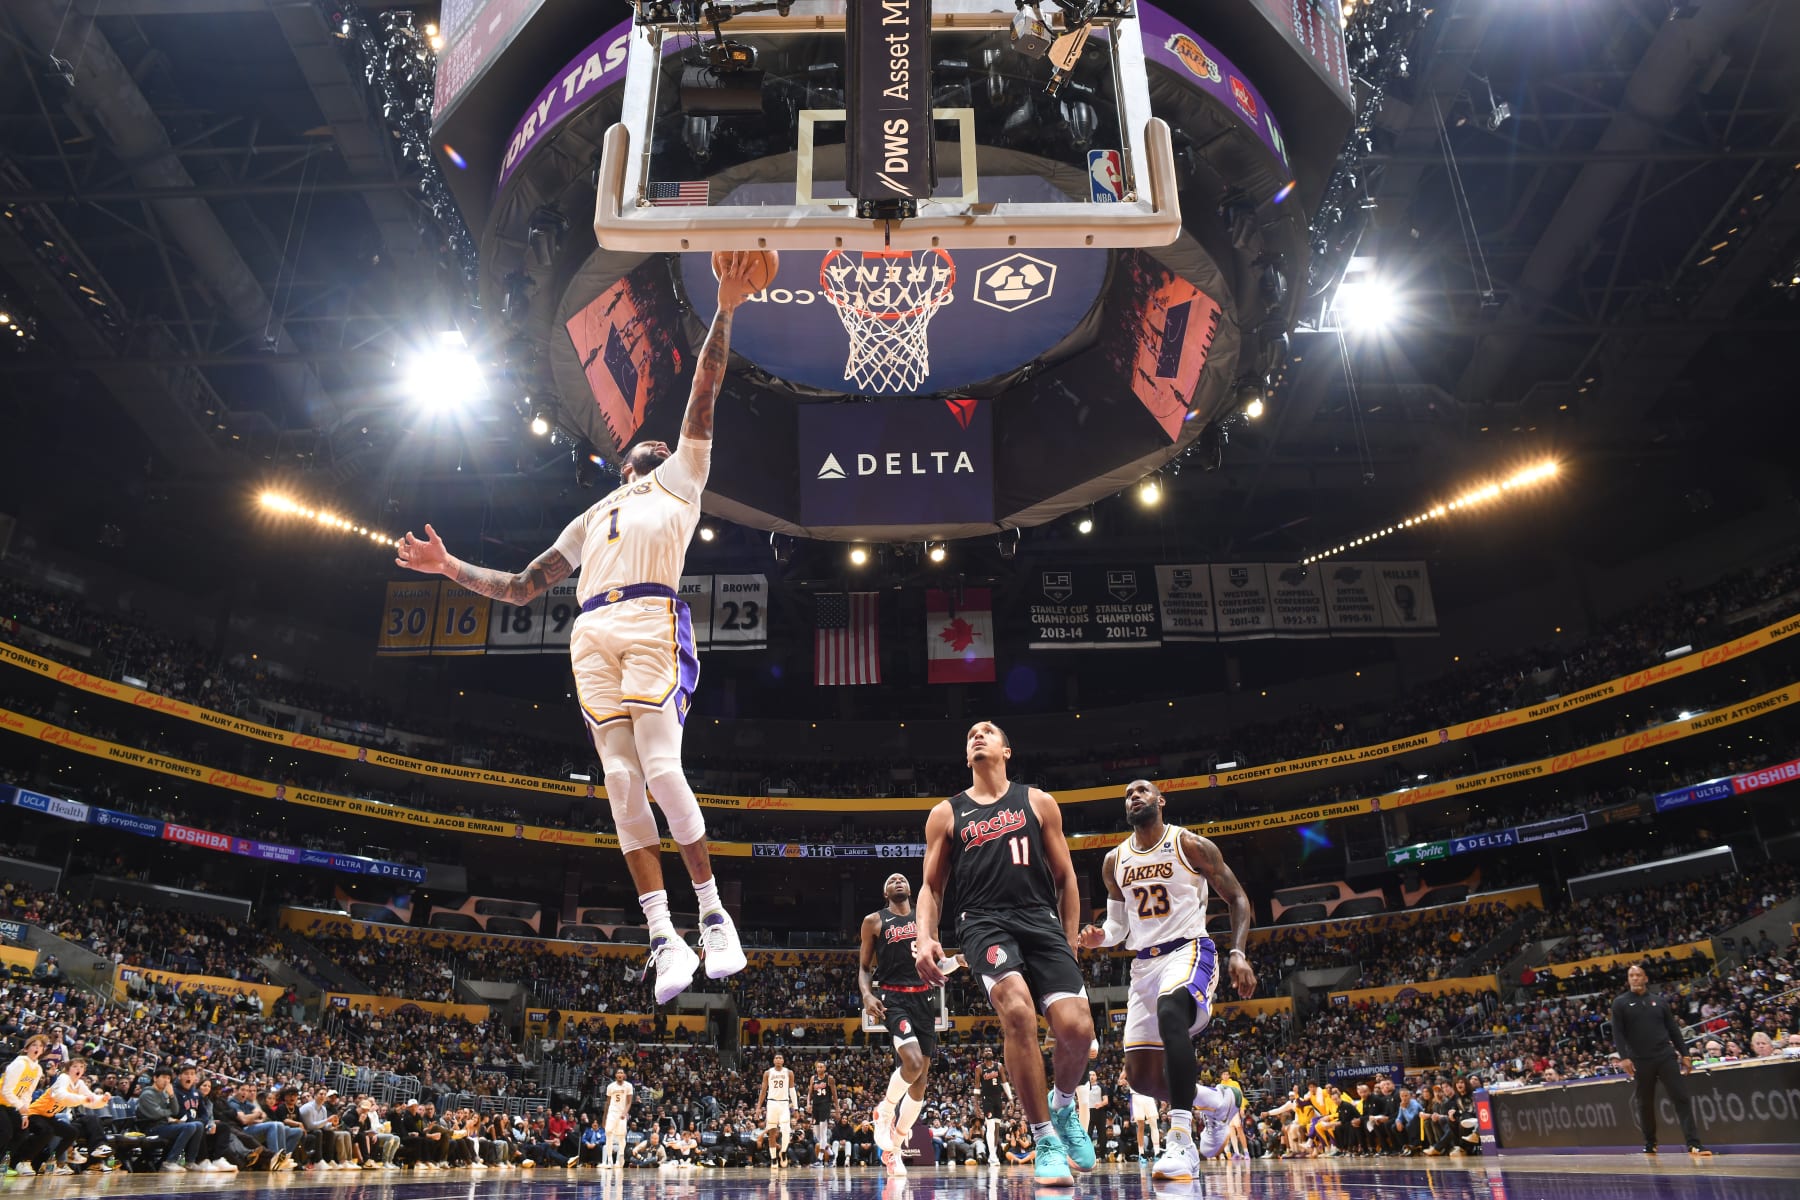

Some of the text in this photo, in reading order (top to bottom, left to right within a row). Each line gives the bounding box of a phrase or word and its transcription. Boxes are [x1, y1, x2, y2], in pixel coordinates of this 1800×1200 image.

[562, 31, 632, 103] TAS
[883, 29, 910, 101] Asset
[884, 118, 909, 175] DWS
[1096, 193, 1113, 203] NBA
[857, 451, 975, 476] DELTA
[607, 507, 621, 545] 1
[1044, 574, 1070, 585] LA
[1109, 573, 1134, 584] LA
[1382, 570, 1420, 579] MILLER
[722, 582, 761, 593] BROWN
[721, 600, 760, 630] 23
[1030, 603, 1088, 614] STANLEY CUP
[1095, 603, 1153, 614] STANLEY CUP
[1222, 607, 1265, 616] CHAMPIONS
[387, 608, 427, 636] 30
[445, 607, 477, 635] 16
[500, 605, 531, 634] 18
[1031, 613, 1089, 624] CHAMPIONS
[1095, 612, 1155, 624] CHAMPIONS
[1039, 626, 1083, 639] 2013-14
[1105, 625, 1147, 638] 2011-12
[1528, 686, 1615, 718] INJURY ATTORNEYS
[1691, 693, 1789, 730] INJURY ATTORNEYS
[200, 712, 285, 742] INJURY ATTORNEYS
[109, 747, 202, 778] INJURY ATTORNEYS
[1227, 737, 1429, 783] ACCIDENT OR INJURY? CALL JACOB EMRANI
[376, 755, 576, 793] ACCIDENT OR INJURY? CALL JACOB EMRANI
[1455, 763, 1543, 791] INJURY ATTORNEYS
[1696, 785, 1729, 799] ULTRA
[23, 795, 45, 808] UCLA
[50, 801, 84, 819] Health
[295, 792, 504, 834] ACCIDENT OR INJURY? CALL JACOB EMRANI
[1207, 826, 1221, 835] OR
[1222, 819, 1262, 832] INJURY?
[1263, 816, 1287, 827] CALL
[1289, 811, 1321, 823] JACOB
[1322, 804, 1360, 817] EMRANI
[111, 815, 157, 832] crypto.com
[961, 807, 1026, 848] ripcity
[168, 826, 228, 849] TOSHIBA
[594, 837, 619, 847] INJUR
[1469, 833, 1512, 848] DELTA
[811, 846, 832, 857] 116
[881, 846, 910, 857] 6:31
[1008, 836, 1030, 867] 11
[1415, 845, 1444, 860] Sprite
[335, 859, 361, 869] ULTRA
[383, 865, 422, 879] DELTA
[1121, 862, 1174, 888] LAKERS
[1132, 883, 1171, 921] 23
[1348, 1065, 1390, 1078] CHAMPIONS
[773, 1079, 784, 1089] 28
[1517, 1101, 1617, 1137] crypto.com
